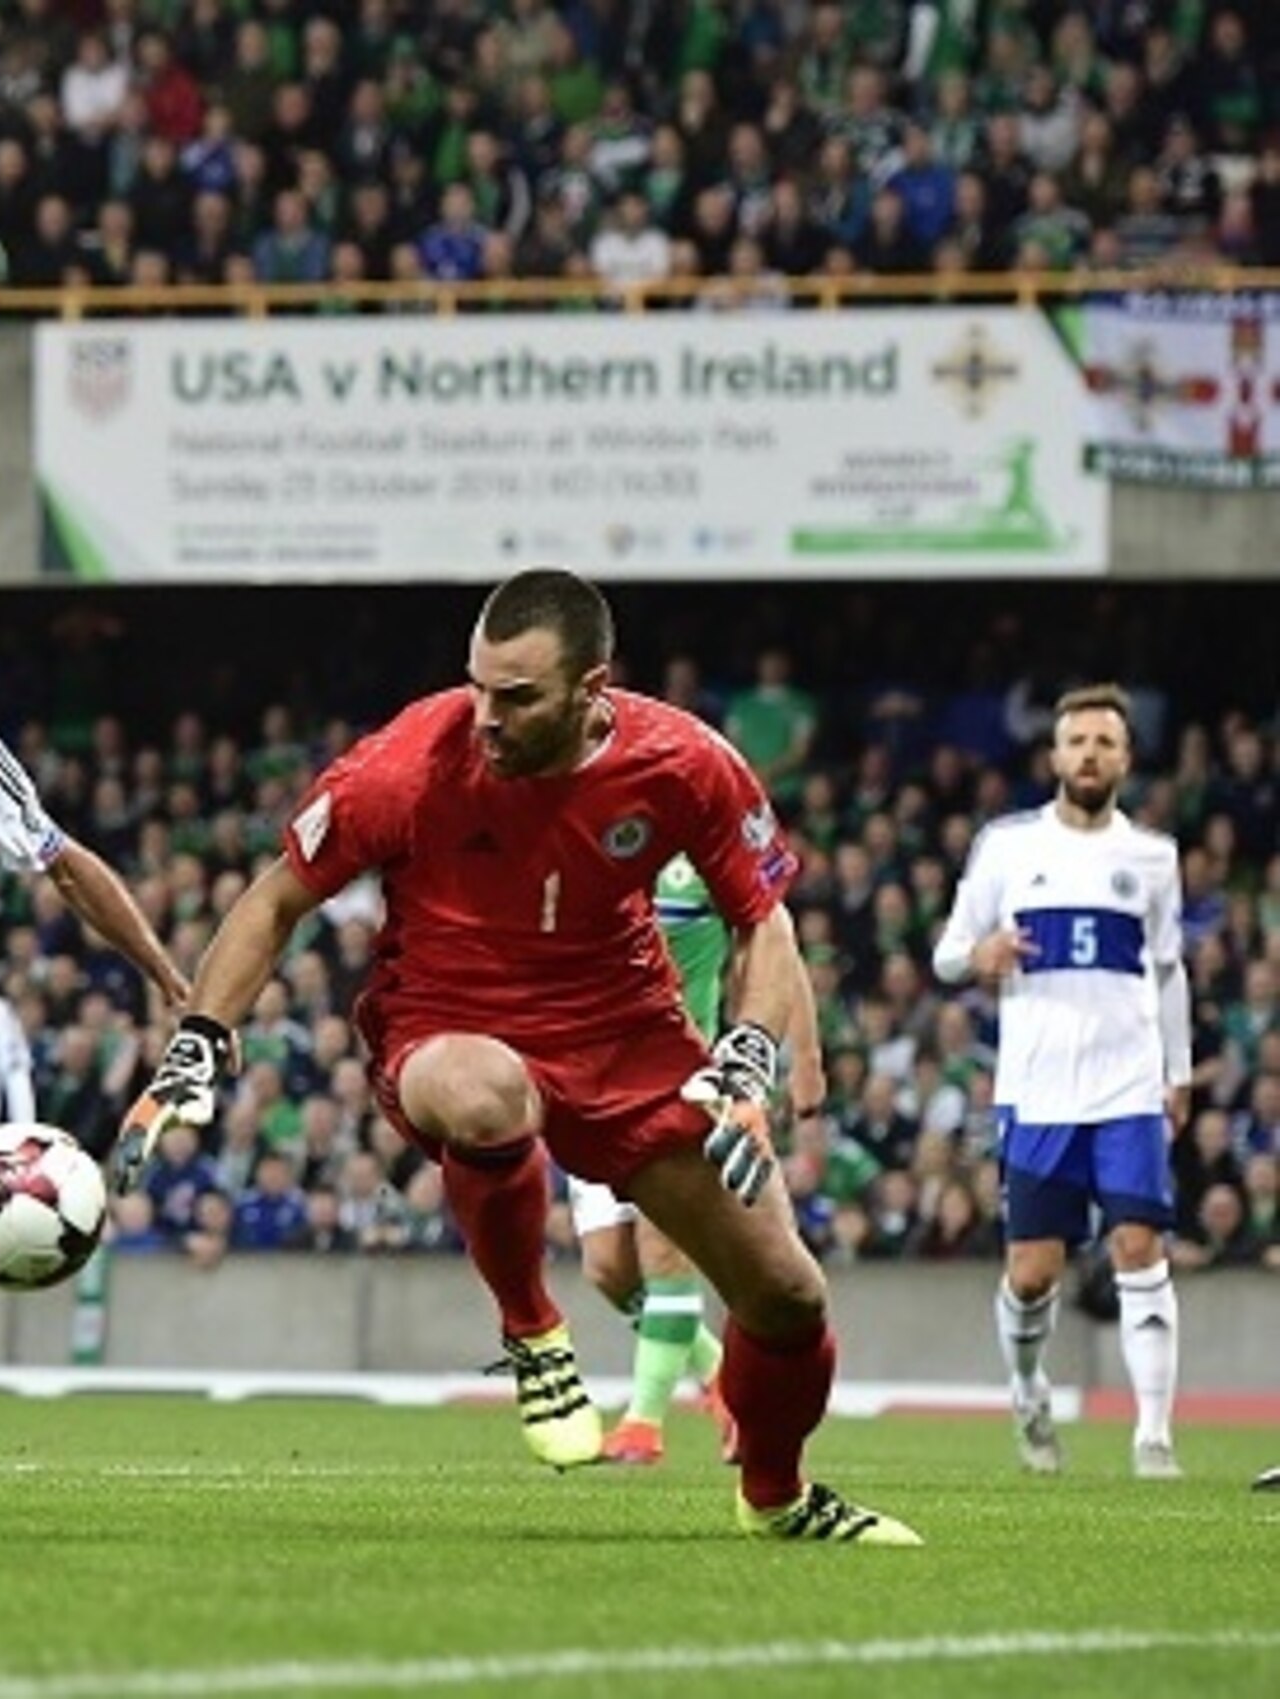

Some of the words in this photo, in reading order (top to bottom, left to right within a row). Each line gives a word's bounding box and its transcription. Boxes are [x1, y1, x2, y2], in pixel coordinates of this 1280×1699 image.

[170, 350, 303, 402] USA
[322, 359, 358, 401] v
[374, 347, 660, 402] Northern
[680, 343, 898, 400] Ireland
[539, 868, 562, 934] 1
[1071, 915, 1098, 967] 5
